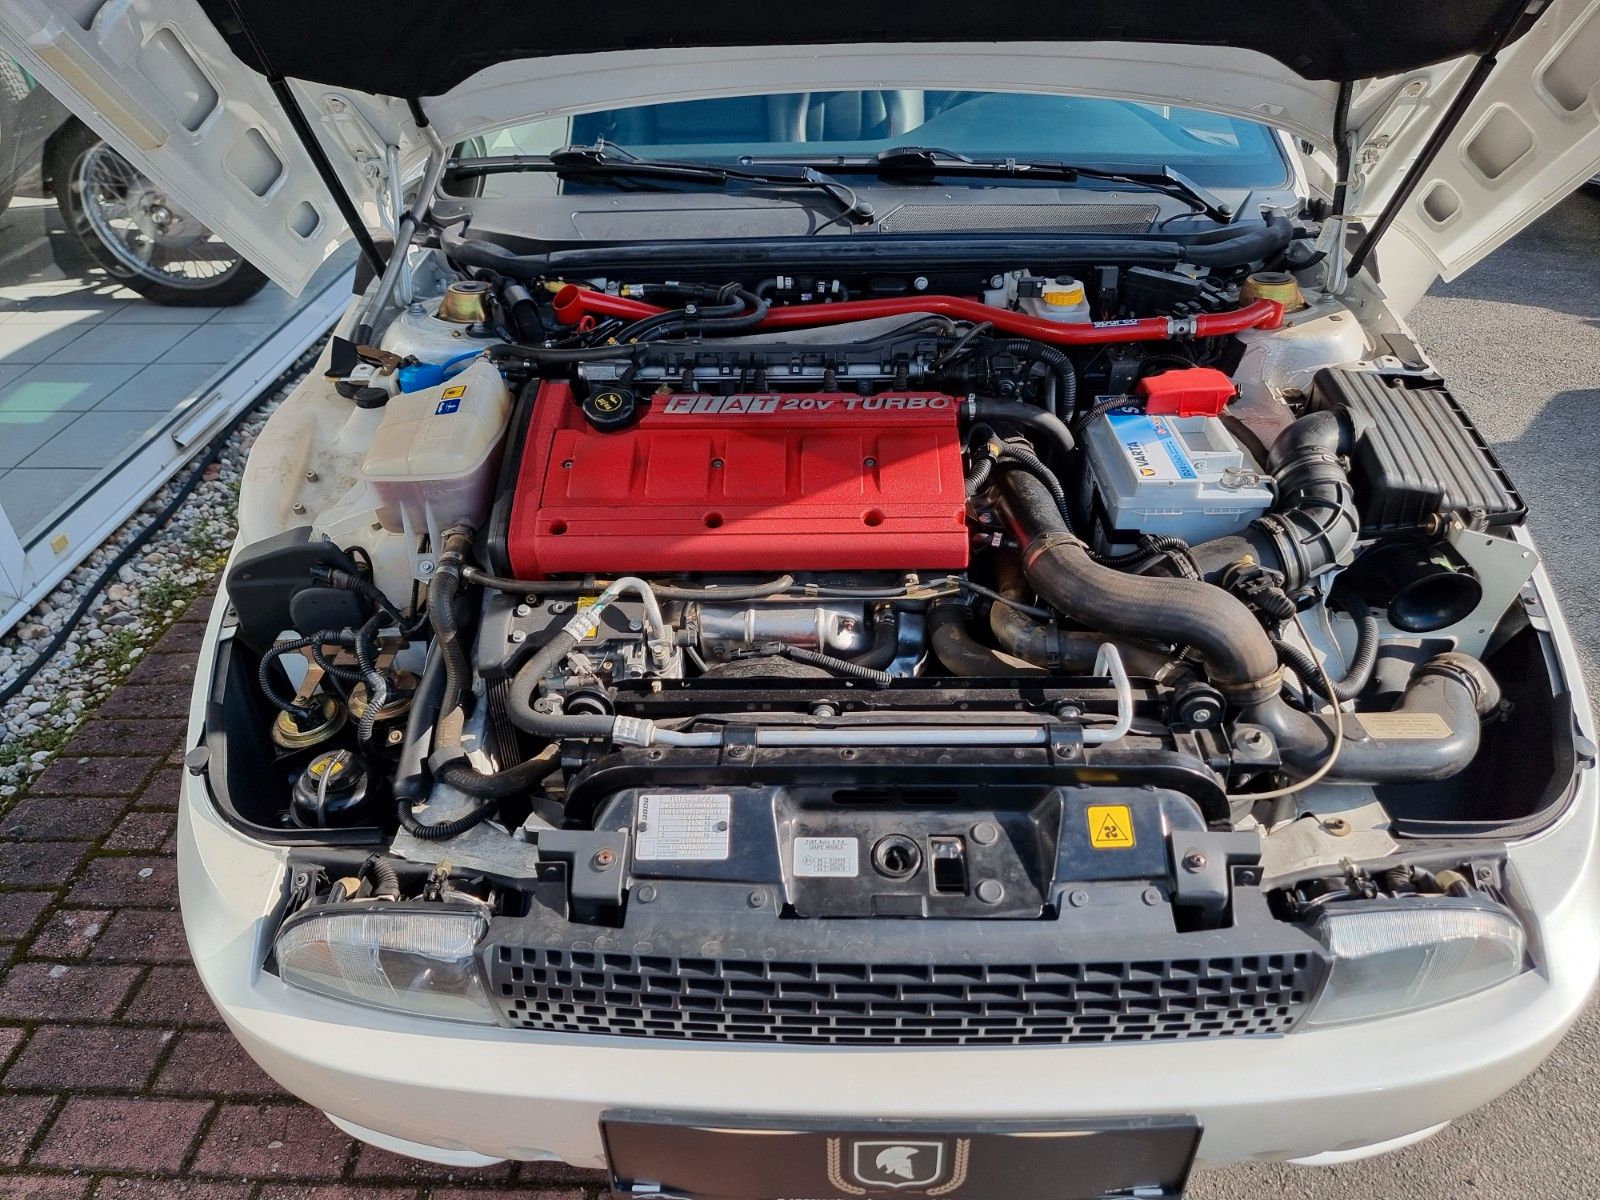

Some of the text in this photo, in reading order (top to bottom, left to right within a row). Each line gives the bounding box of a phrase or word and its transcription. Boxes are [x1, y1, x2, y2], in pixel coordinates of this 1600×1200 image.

[665, 396, 780, 413] FIAT
[843, 397, 950, 410] TURBO
[1126, 441, 1149, 467] VARTA
